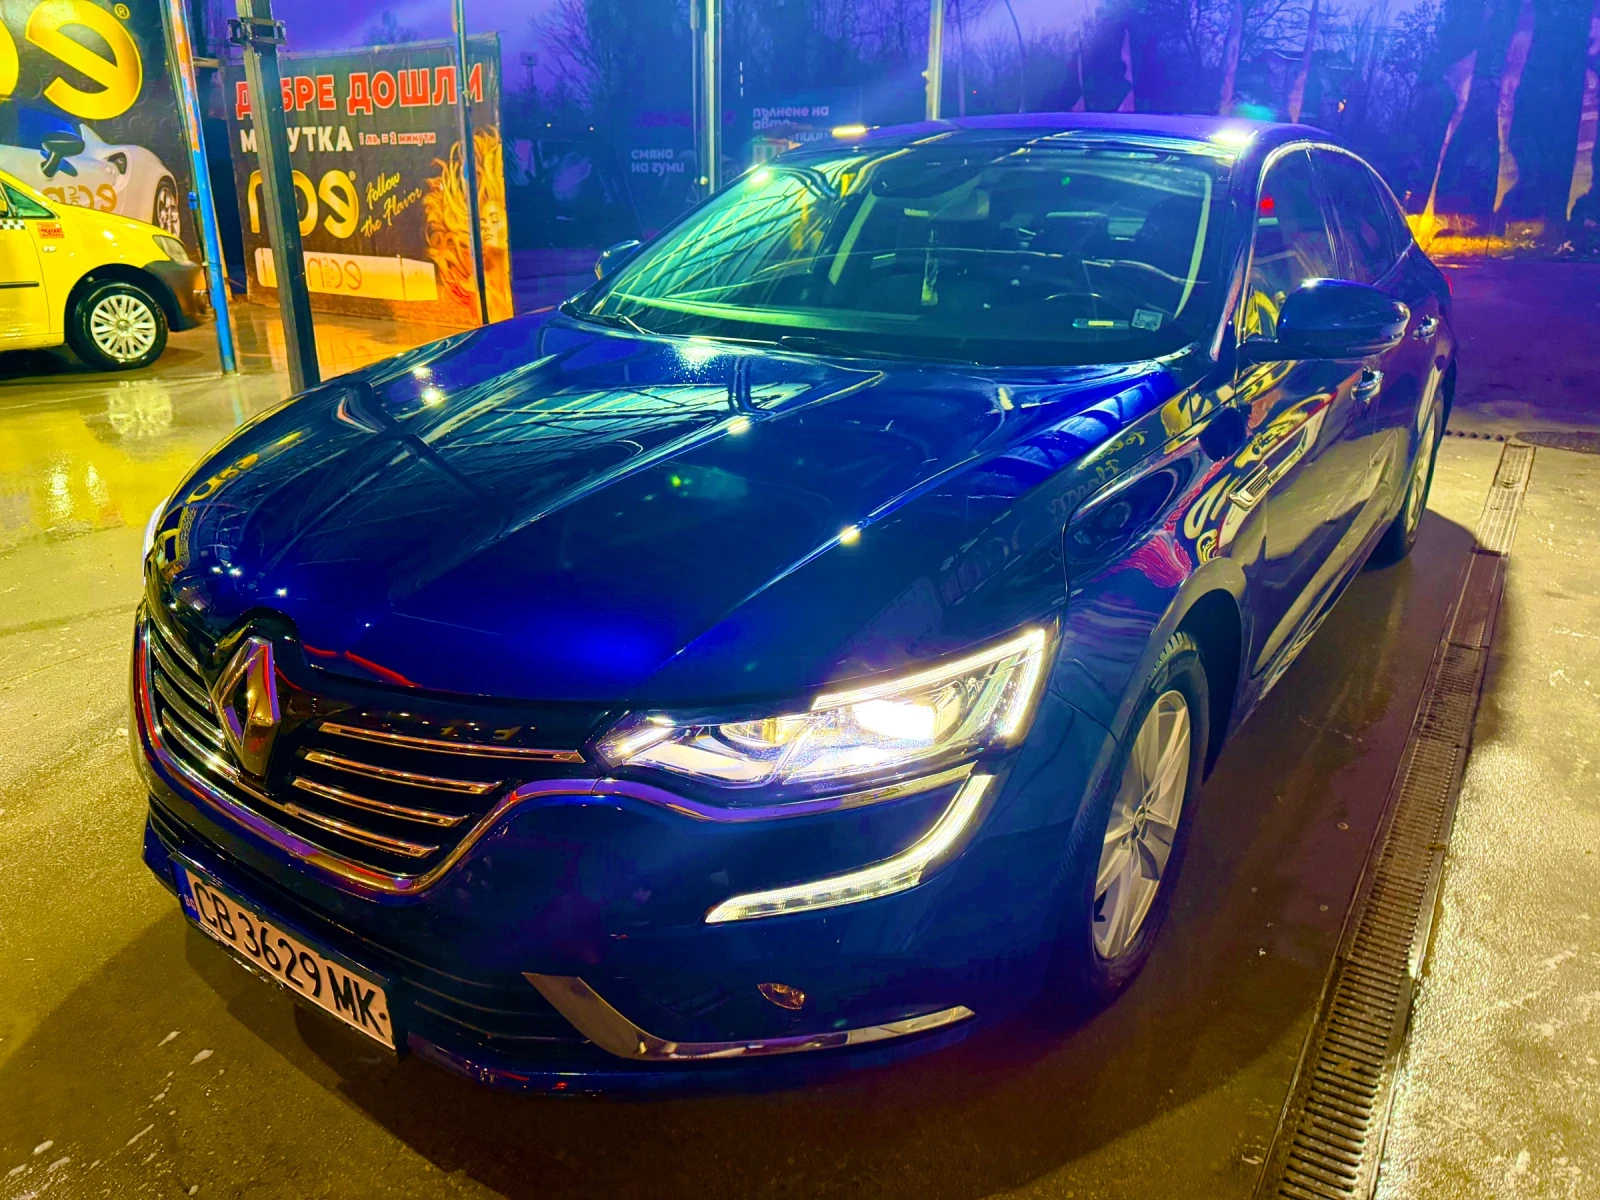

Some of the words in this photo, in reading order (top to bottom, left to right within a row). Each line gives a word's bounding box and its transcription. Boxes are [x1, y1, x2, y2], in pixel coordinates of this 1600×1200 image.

[236, 74, 336, 120] ДБРЕ
[346, 63, 483, 115] ДОШЛИ
[811, 105, 829, 117] на
[240, 126, 354, 152] МУТКА
[358, 131, 365, 146] 1
[390, 131, 398, 145] 2
[398, 132, 437, 147] минути
[631, 149, 674, 160] смяна
[631, 162, 649, 173] на
[651, 162, 685, 176] гуми
[365, 172, 401, 210] Follow
[360, 214, 383, 238] the
[382, 187, 423, 227] Flavor
[193, 881, 237, 941] CB
[237, 911, 322, 998] 3629
[326, 965, 386, 1037] MK
